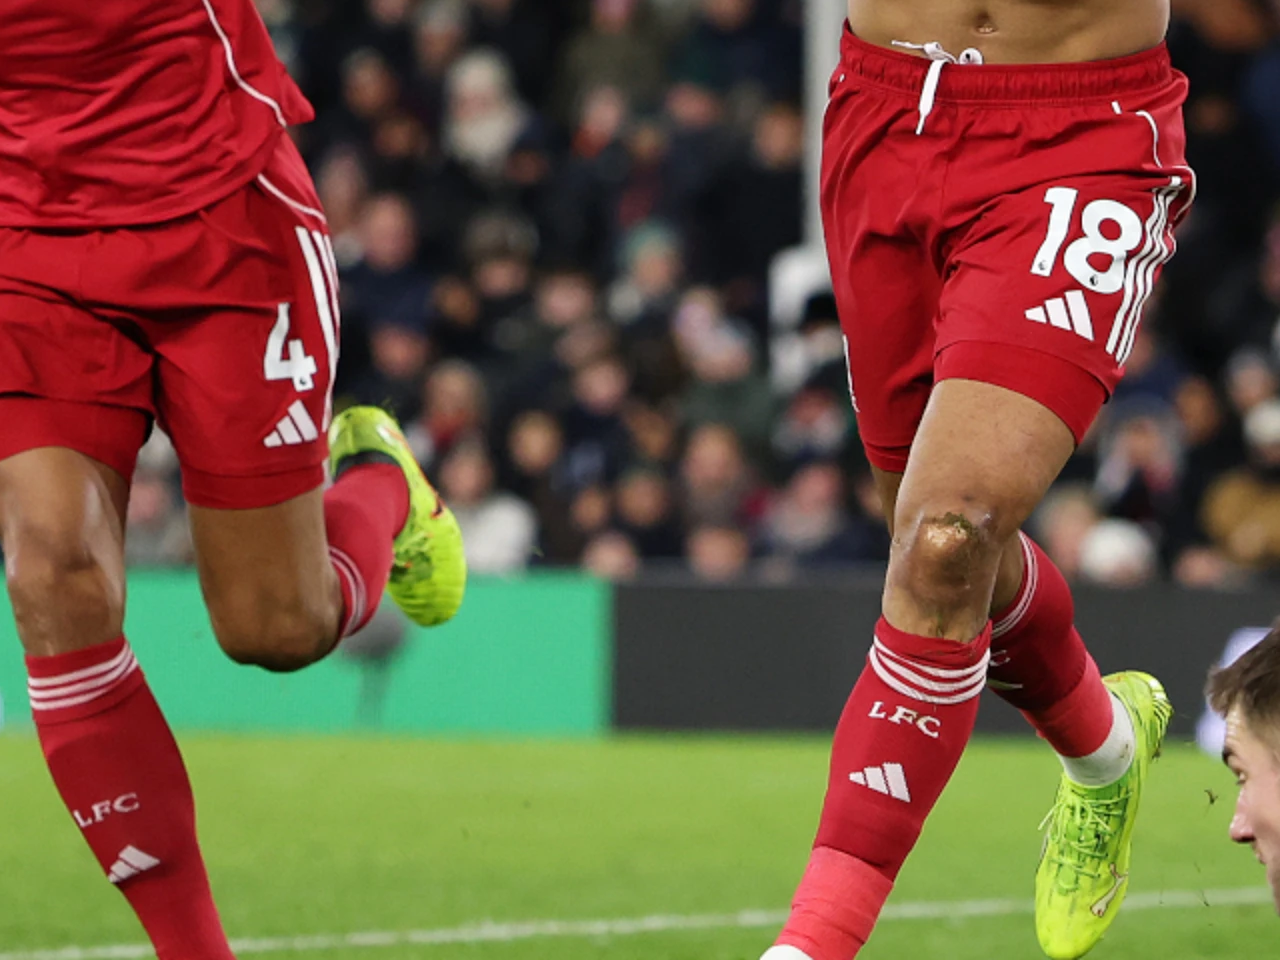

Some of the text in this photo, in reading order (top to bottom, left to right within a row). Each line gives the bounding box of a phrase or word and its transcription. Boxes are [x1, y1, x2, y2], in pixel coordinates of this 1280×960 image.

[1030, 187, 1142, 294] 18
[264, 303, 317, 392] 4
[868, 701, 941, 738] LFC
[73, 791, 139, 828] LFC
